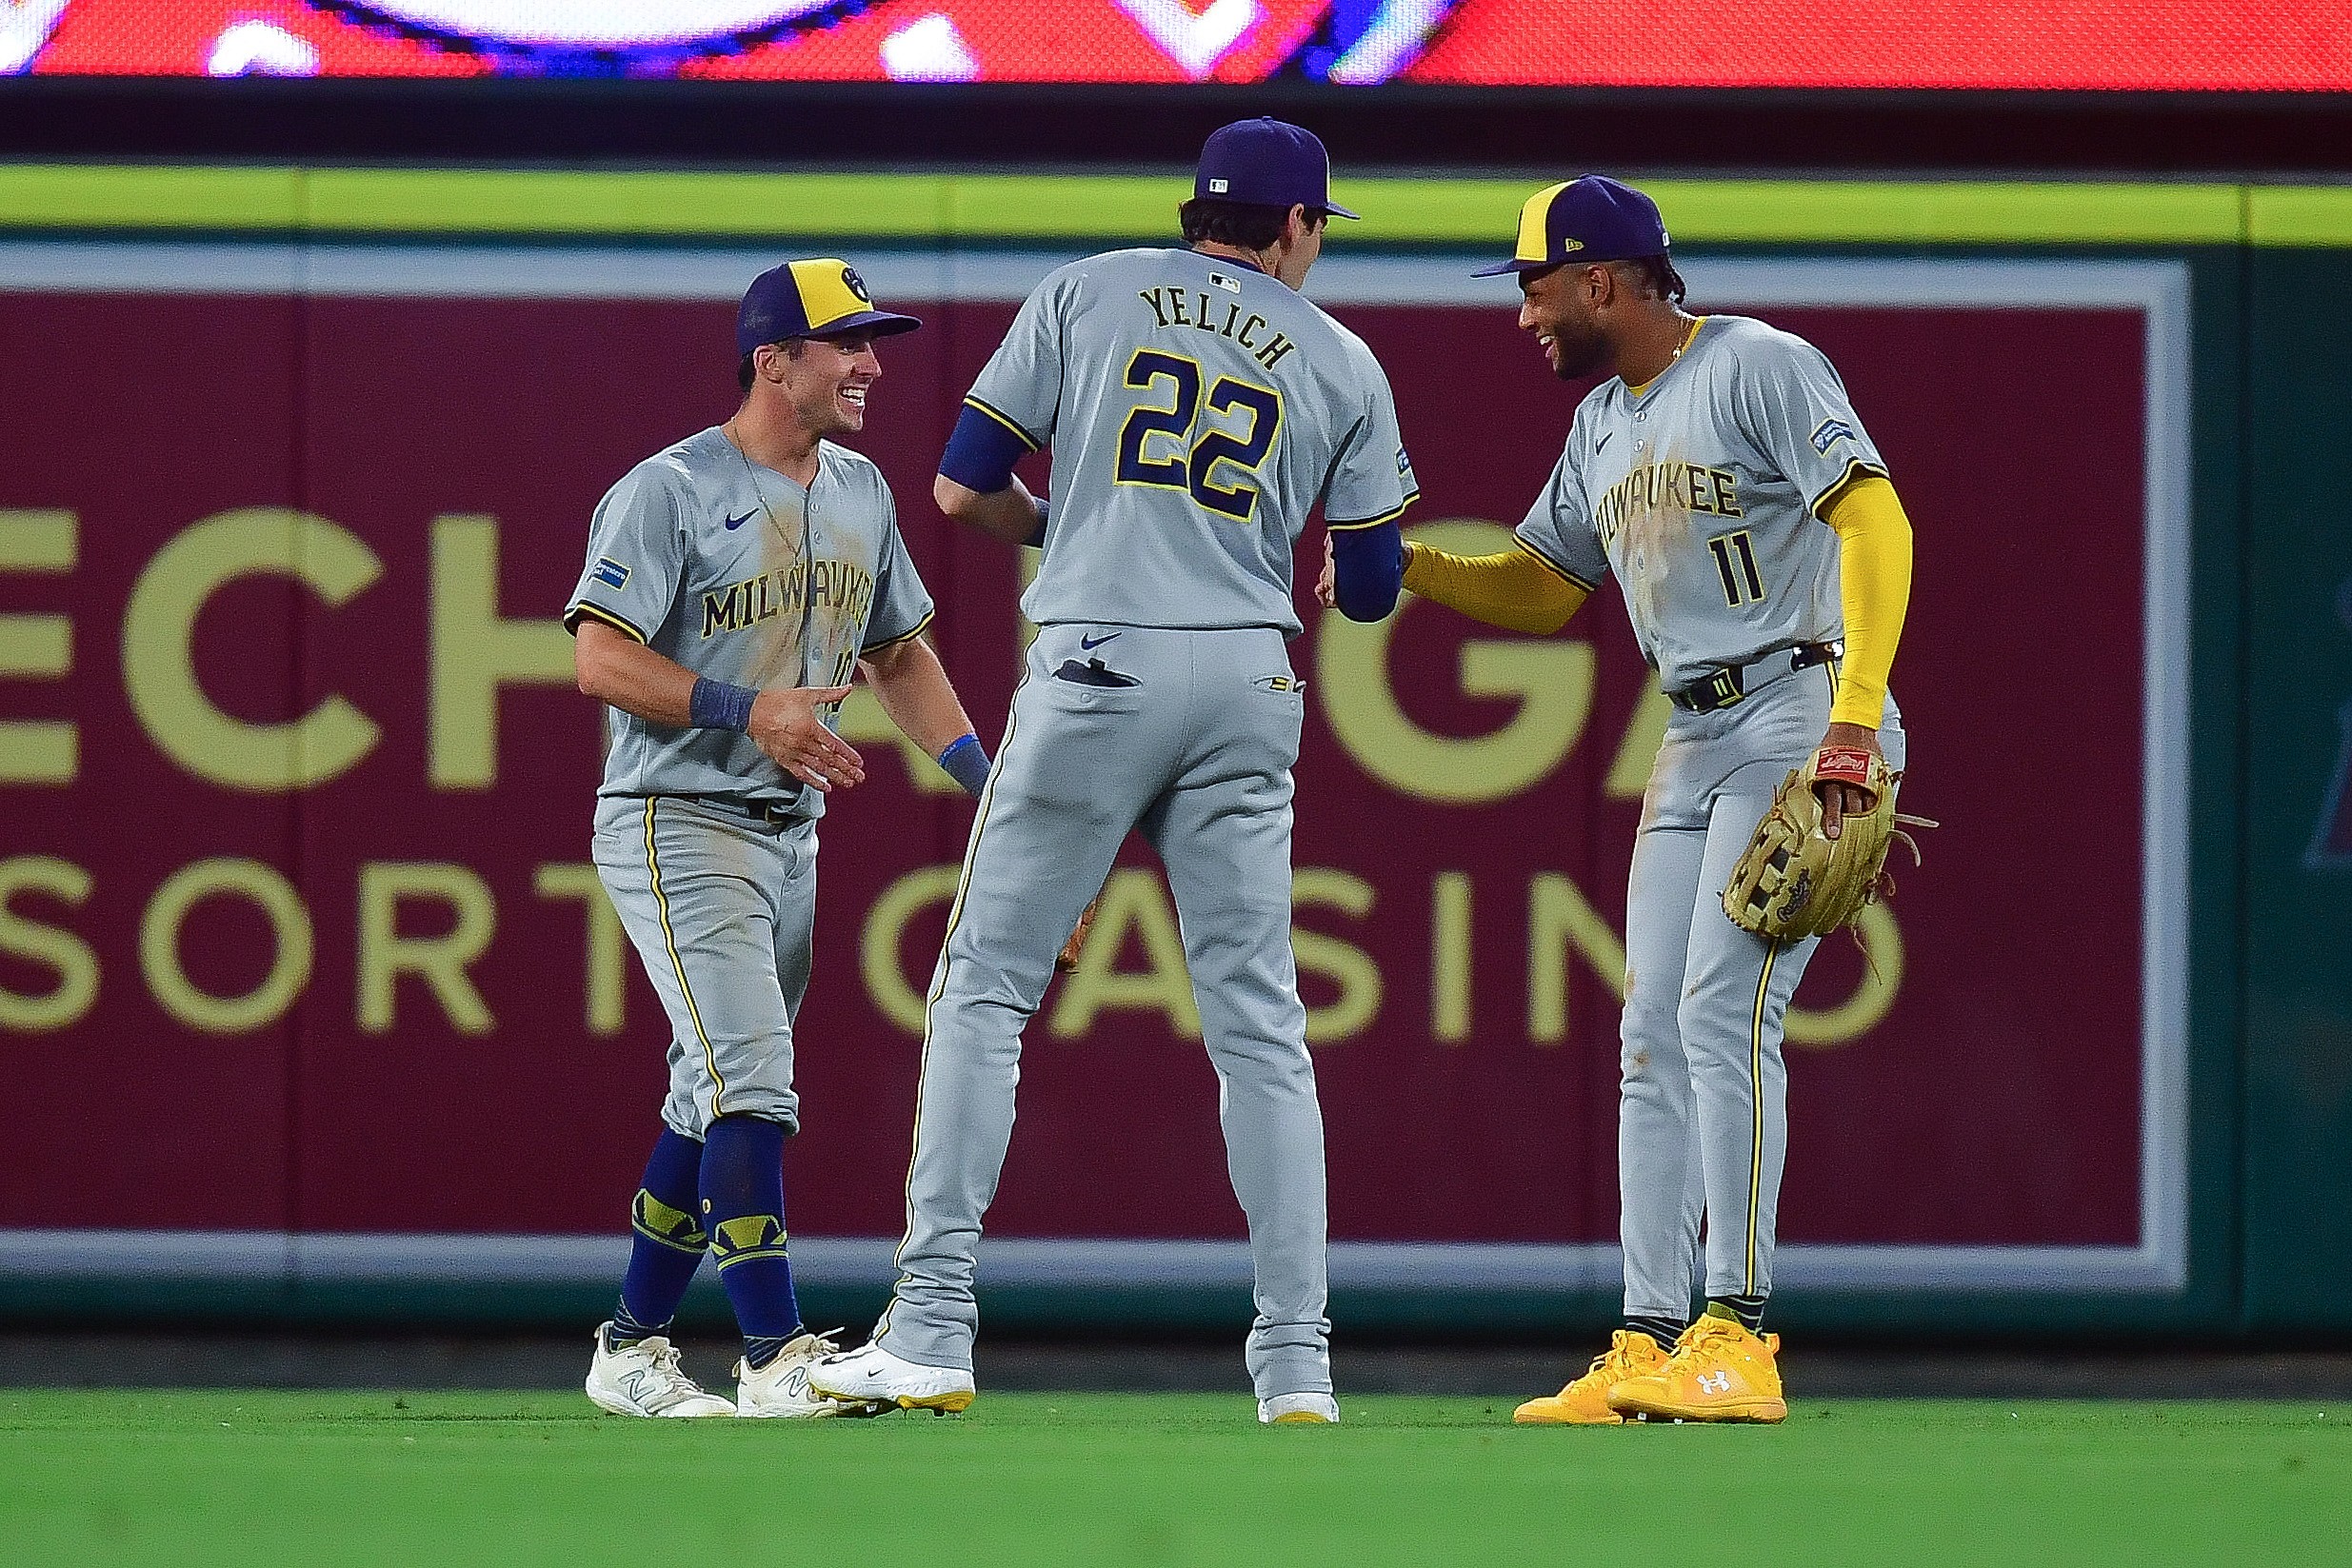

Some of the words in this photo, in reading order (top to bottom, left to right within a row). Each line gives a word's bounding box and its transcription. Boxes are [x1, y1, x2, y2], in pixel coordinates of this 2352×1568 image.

[1140, 287, 1295, 373] YELICH
[1113, 347, 1286, 525] 22
[1707, 529, 1765, 608] 11
